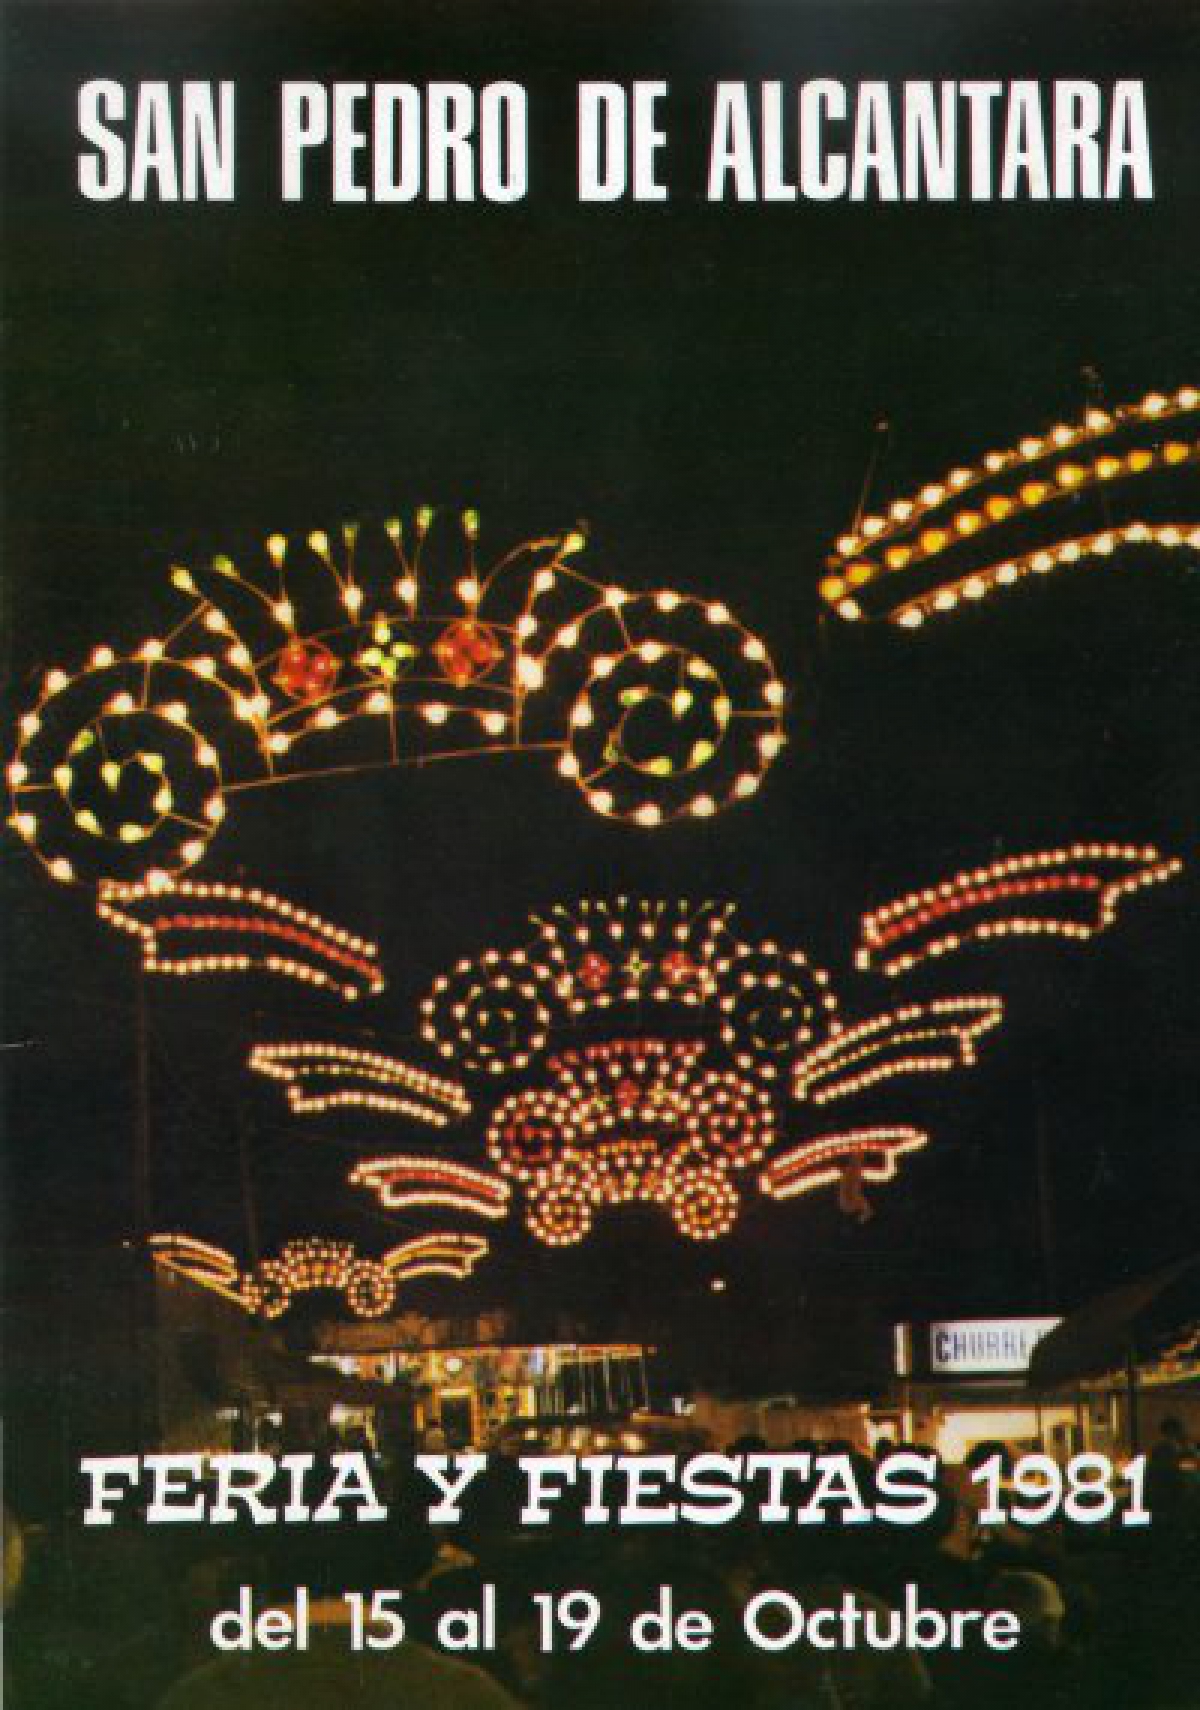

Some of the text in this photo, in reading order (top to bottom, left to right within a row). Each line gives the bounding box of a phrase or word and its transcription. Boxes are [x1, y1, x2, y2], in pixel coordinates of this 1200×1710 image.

[78, 78, 1153, 203] SAN PEDRO DE ALCANTARA
[81, 1453, 1151, 1526] FERIA Y FIESTAS 1981
[209, 1584, 1021, 1651] del 15 al 19 de Octubre
